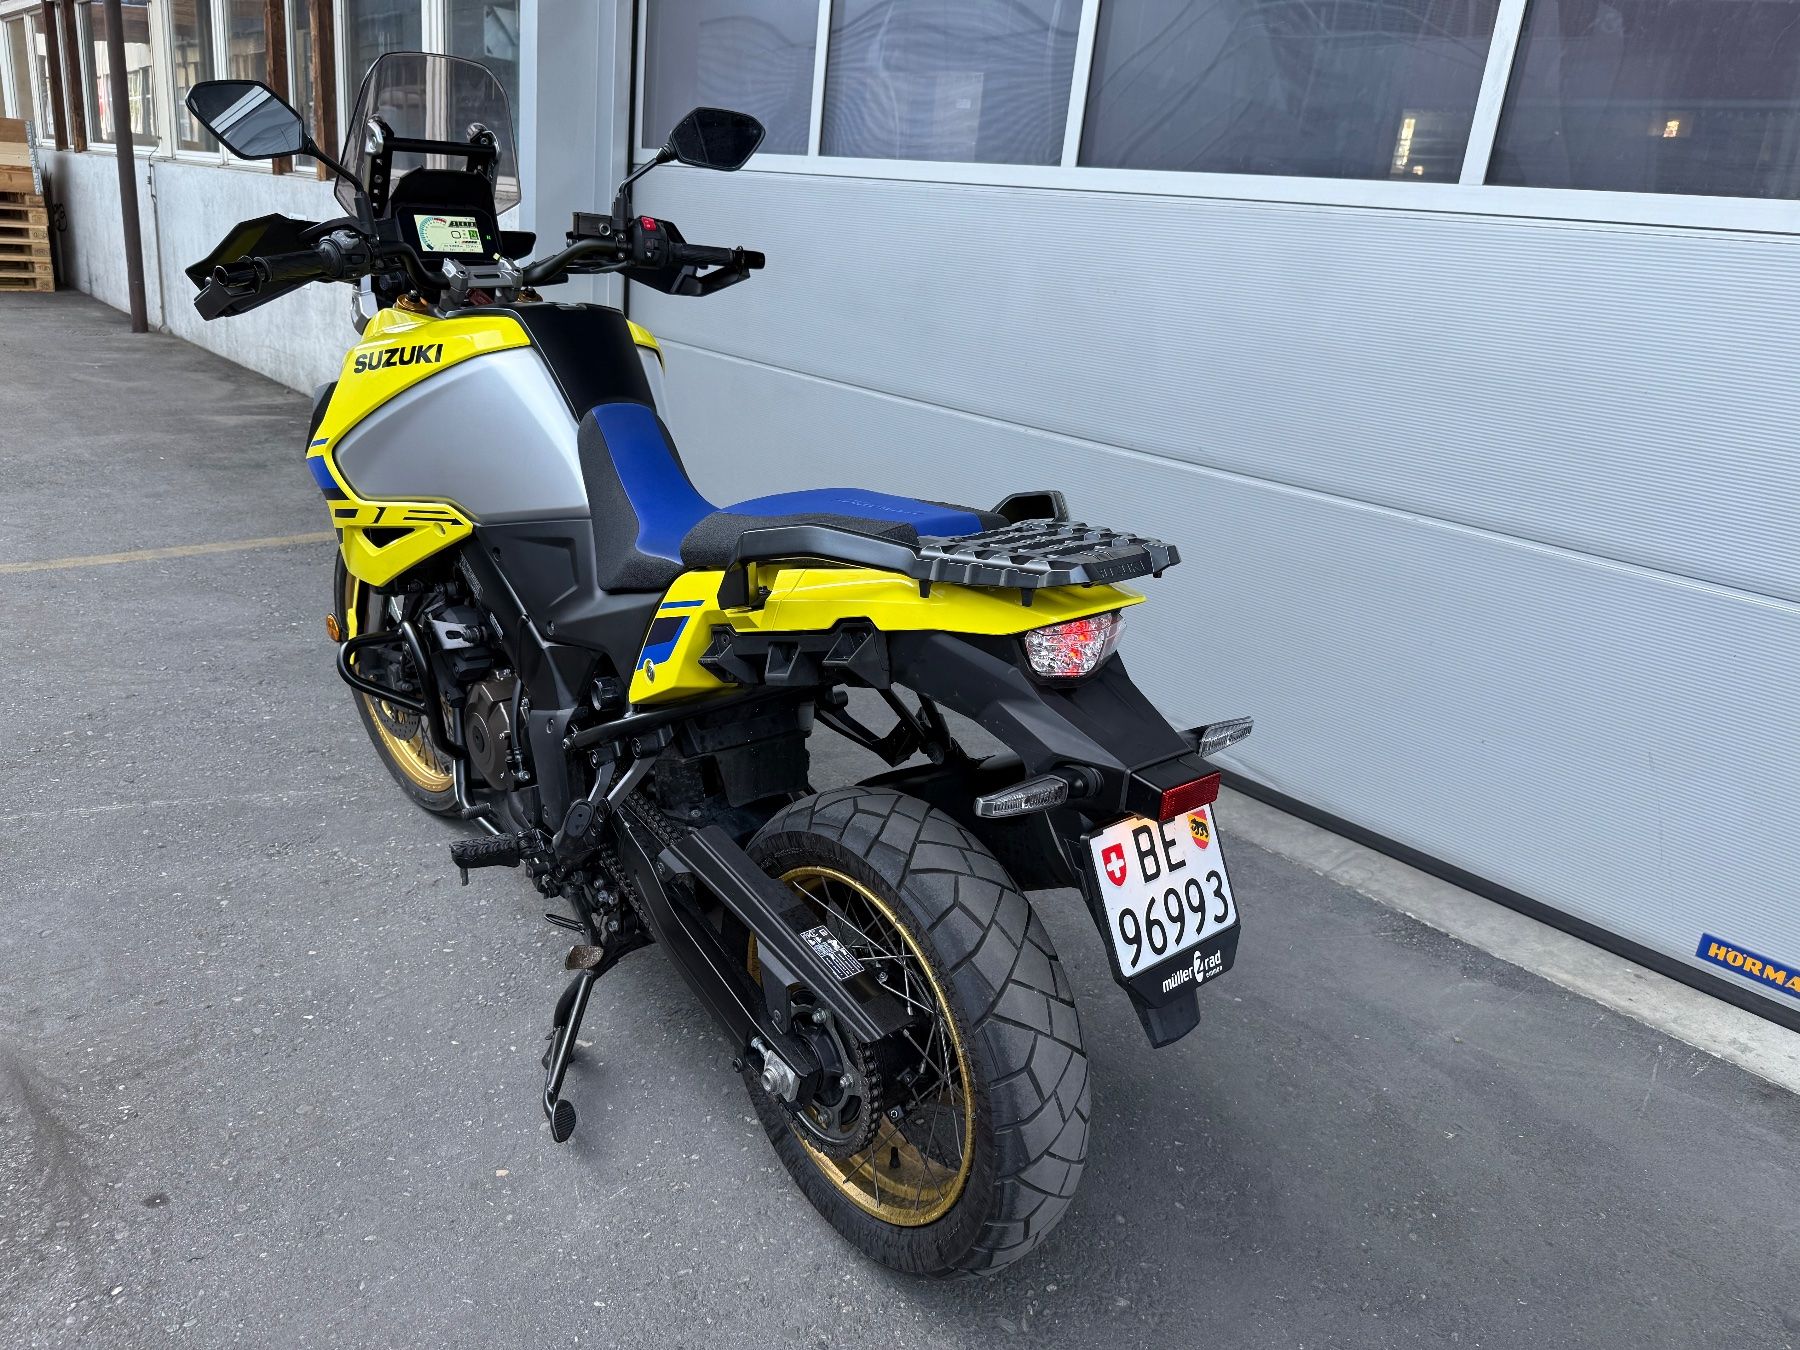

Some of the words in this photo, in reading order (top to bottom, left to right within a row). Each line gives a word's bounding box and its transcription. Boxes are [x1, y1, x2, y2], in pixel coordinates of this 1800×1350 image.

[354, 344, 443, 373] SUZUKI
[1131, 817, 1187, 883] BE
[1118, 869, 1229, 968] 96993
